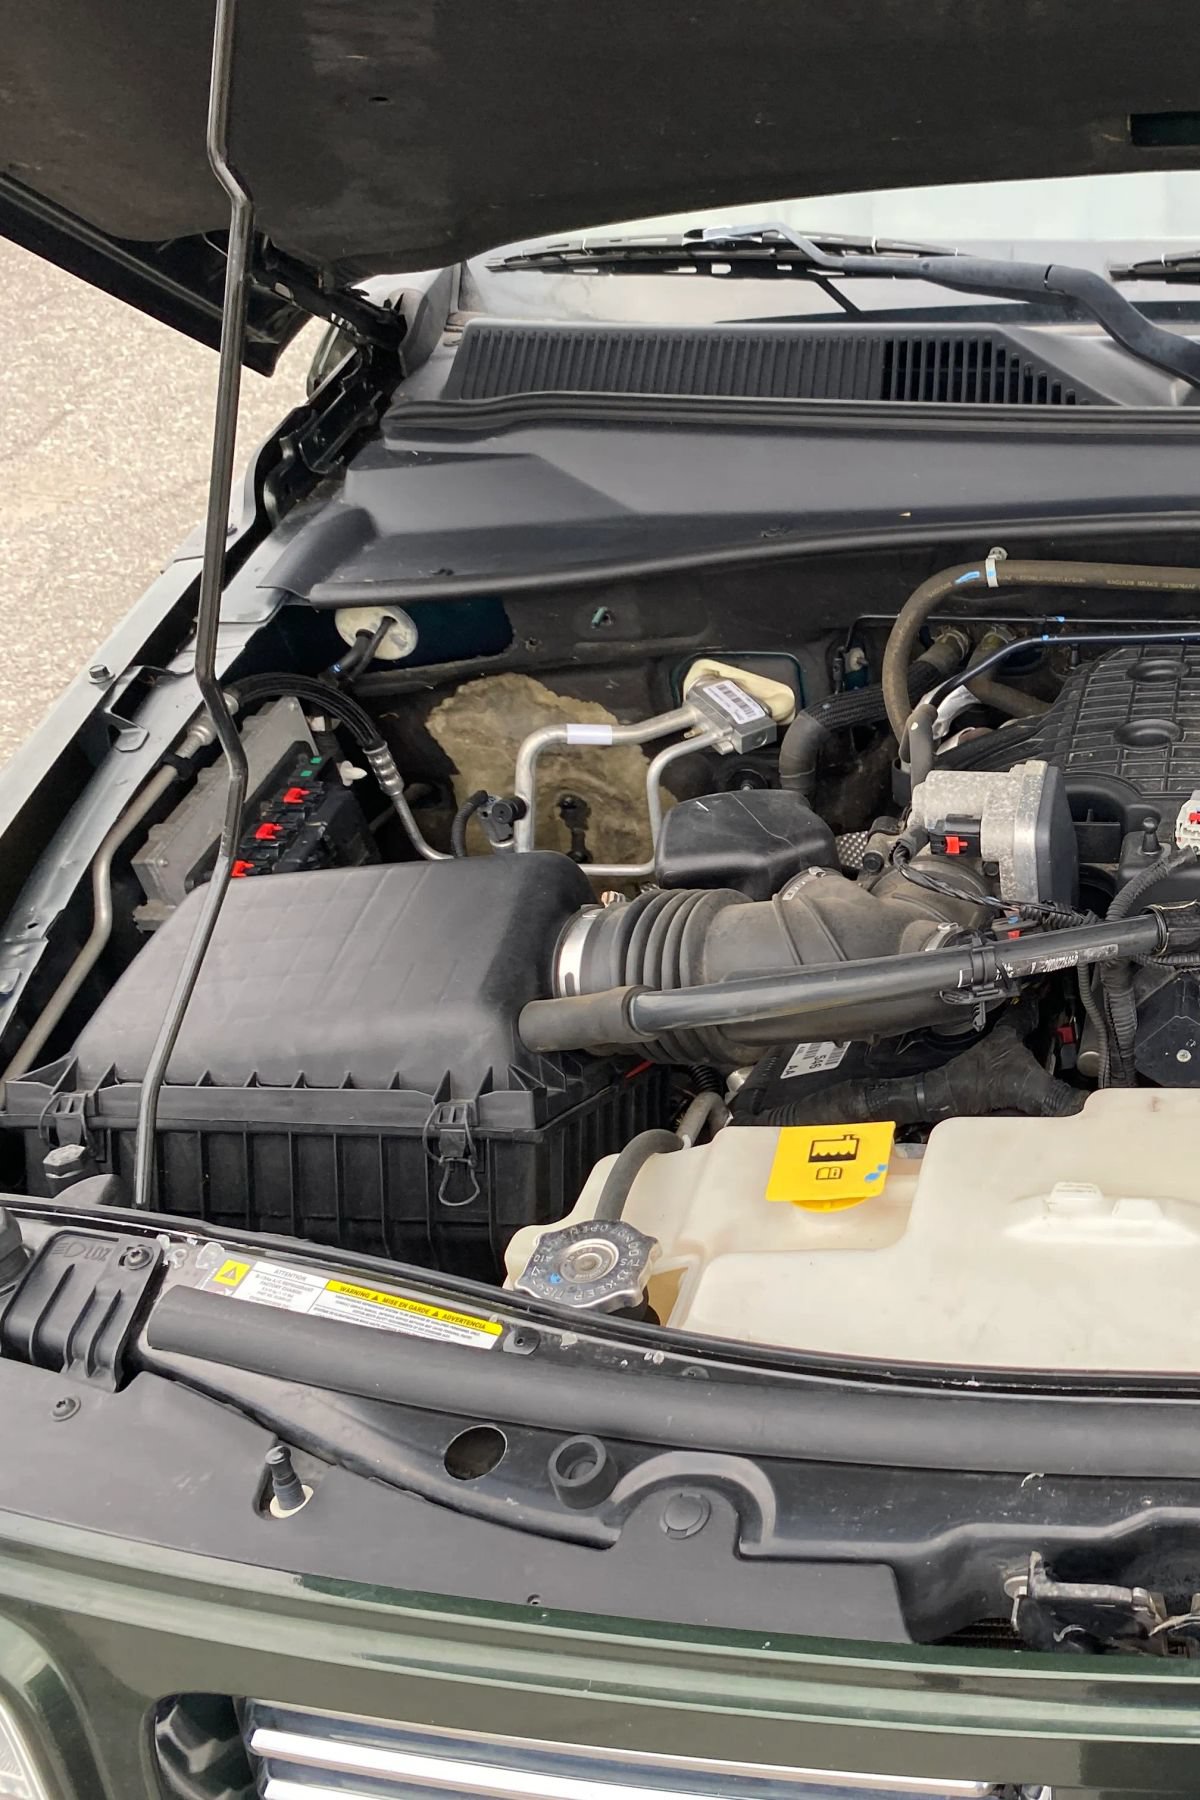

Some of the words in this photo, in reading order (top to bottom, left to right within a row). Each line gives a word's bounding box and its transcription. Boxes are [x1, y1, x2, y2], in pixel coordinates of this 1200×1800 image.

[273, 1268, 308, 1282] ATTENTION
[340, 1286, 370, 1299] WARNING
[382, 1296, 398, 1307] MISE
[408, 1303, 429, 1315] GARDE
[442, 1313, 487, 1330] ADVERTENCIA
